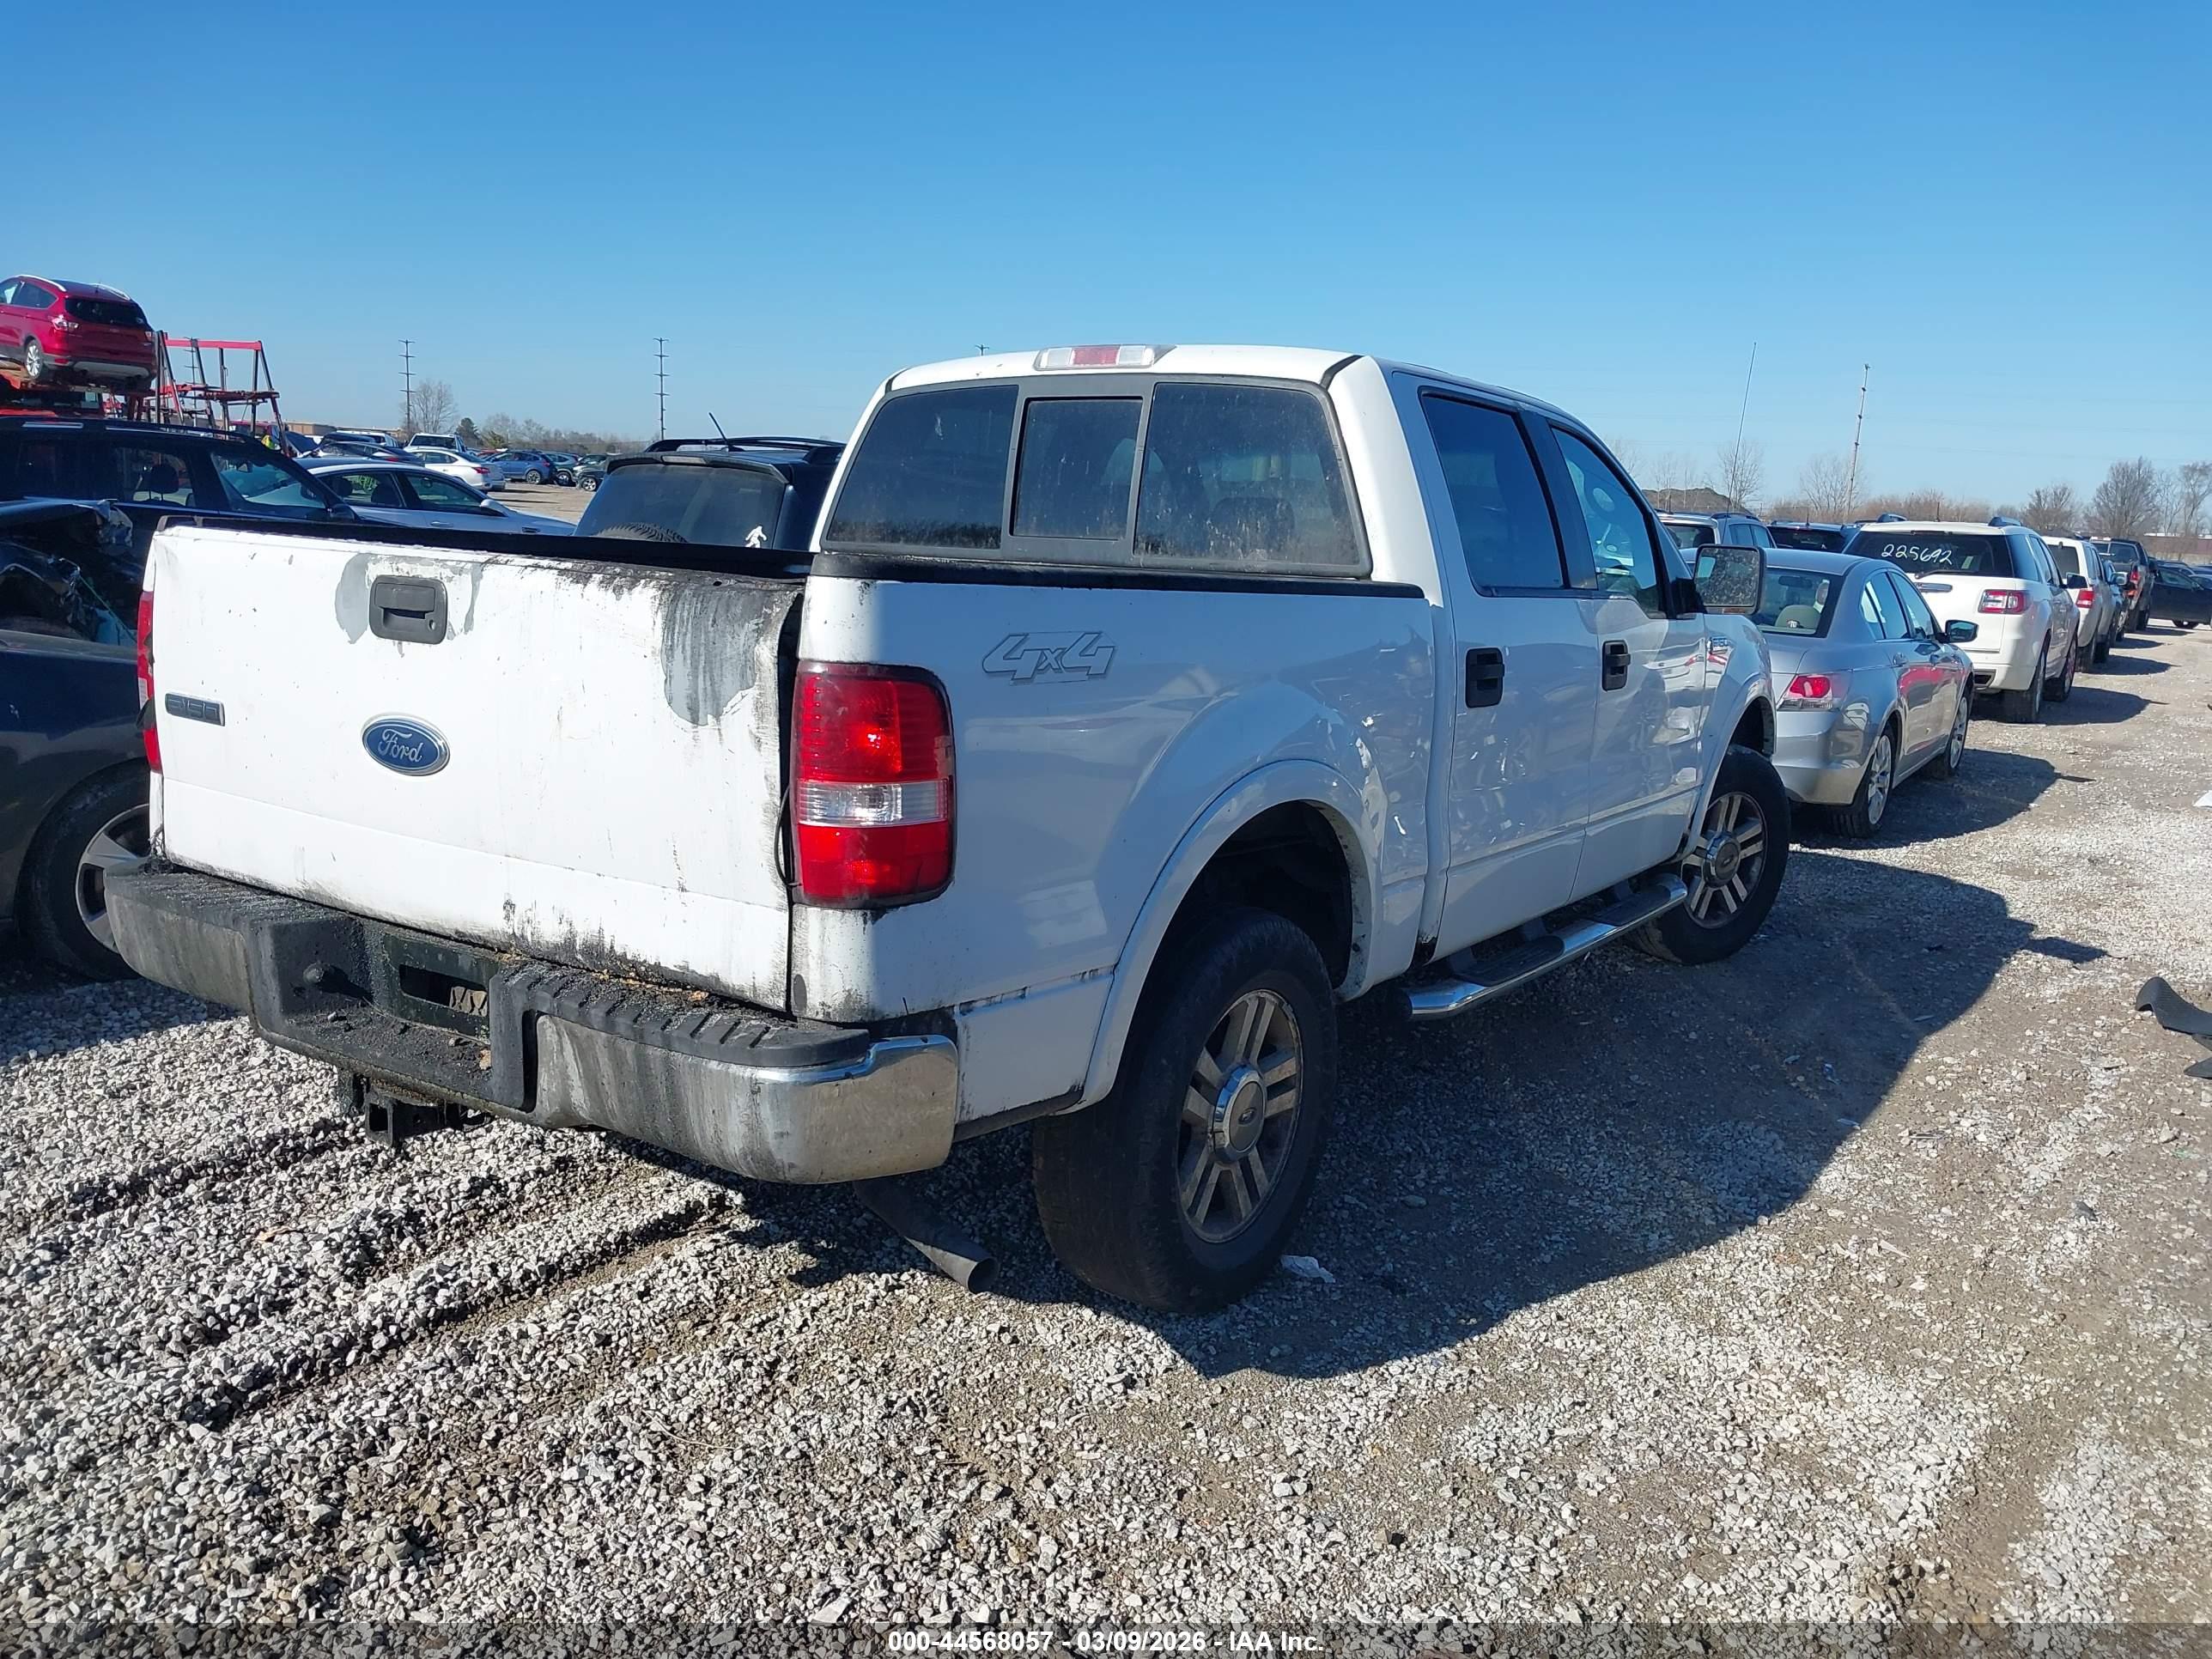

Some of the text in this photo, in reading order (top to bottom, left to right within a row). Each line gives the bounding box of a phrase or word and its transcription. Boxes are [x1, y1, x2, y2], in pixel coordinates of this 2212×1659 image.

[1881, 544, 1953, 565] 225692
[982, 632, 1115, 681] 4x4
[378, 728, 424, 763] Ford
